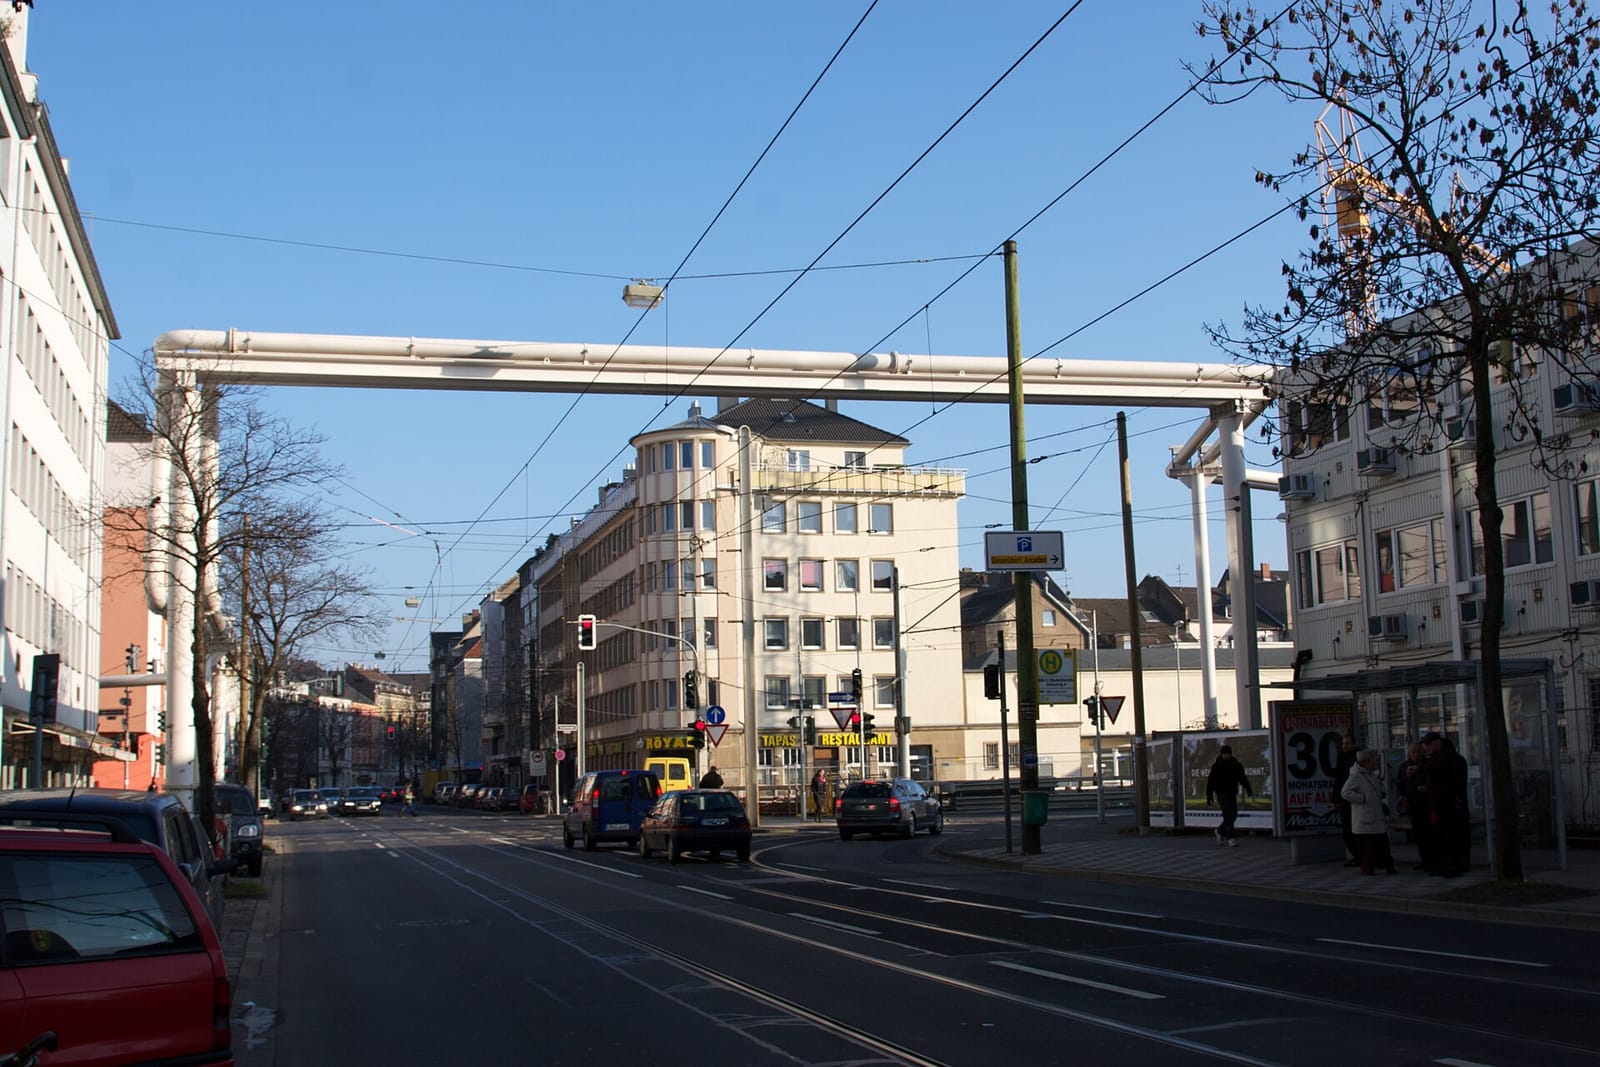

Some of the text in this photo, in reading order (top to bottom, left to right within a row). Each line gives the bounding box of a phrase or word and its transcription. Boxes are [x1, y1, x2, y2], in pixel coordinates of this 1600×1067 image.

[762, 733, 892, 747] TAPAS RESTAUANT
[1287, 731, 1344, 780] 30
[1289, 792, 1312, 804] AUF
